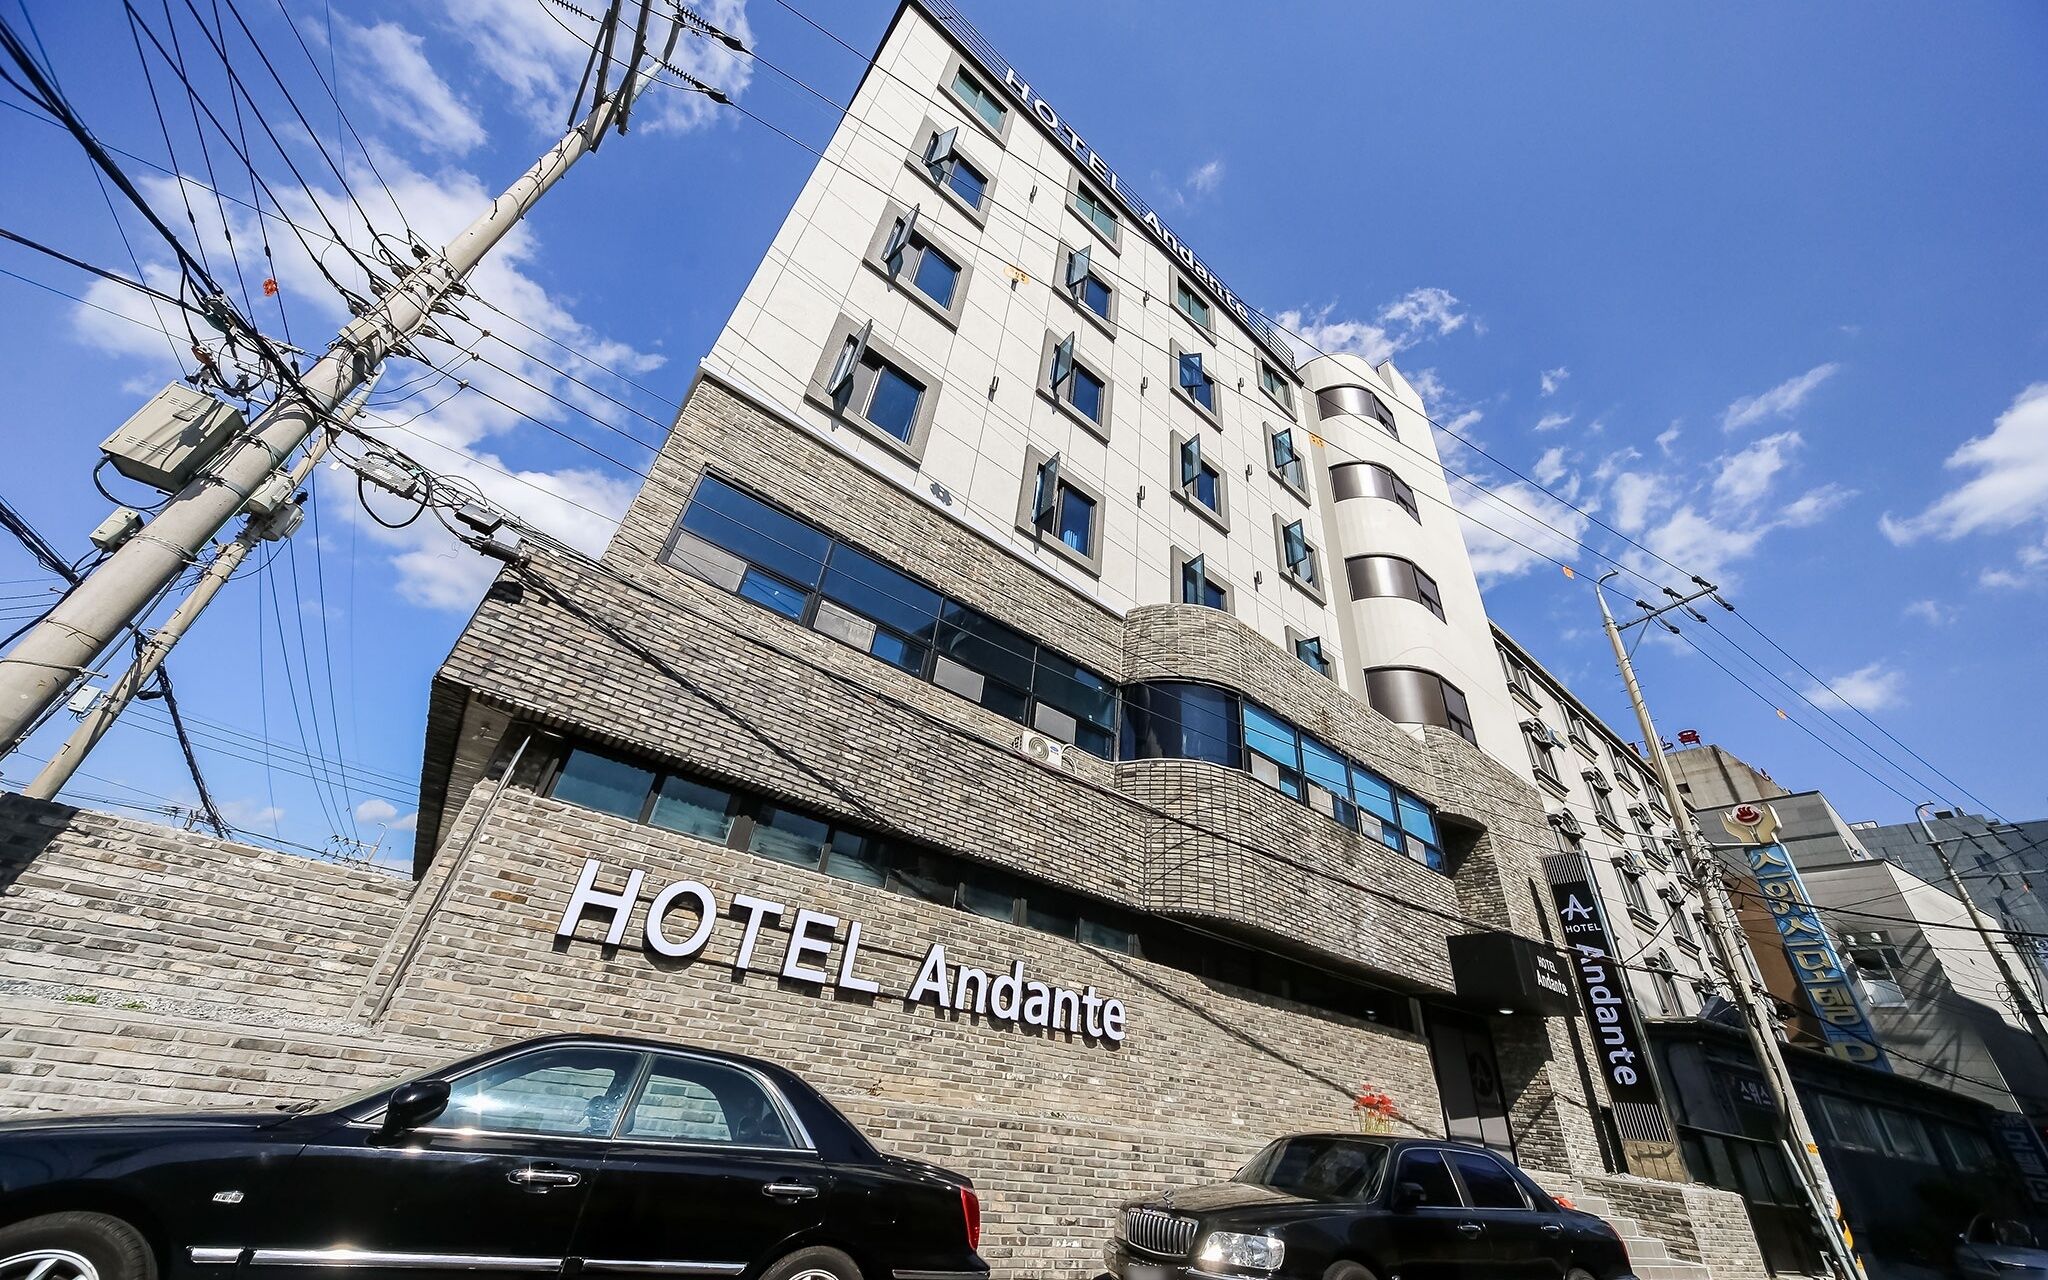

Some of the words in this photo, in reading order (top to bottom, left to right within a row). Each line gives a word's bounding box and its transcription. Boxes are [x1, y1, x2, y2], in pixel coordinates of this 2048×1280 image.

[1004, 67, 1127, 202] HOTEL
[1144, 211, 1250, 322] Andante
[556, 858, 879, 992] HOTEL
[908, 943, 1127, 1041] Andante
[1536, 955, 1558, 974] HOTEL
[1565, 922, 1602, 934] HOTEL
[1536, 969, 1568, 996] Andante
[1576, 943, 1638, 1086] Andante
